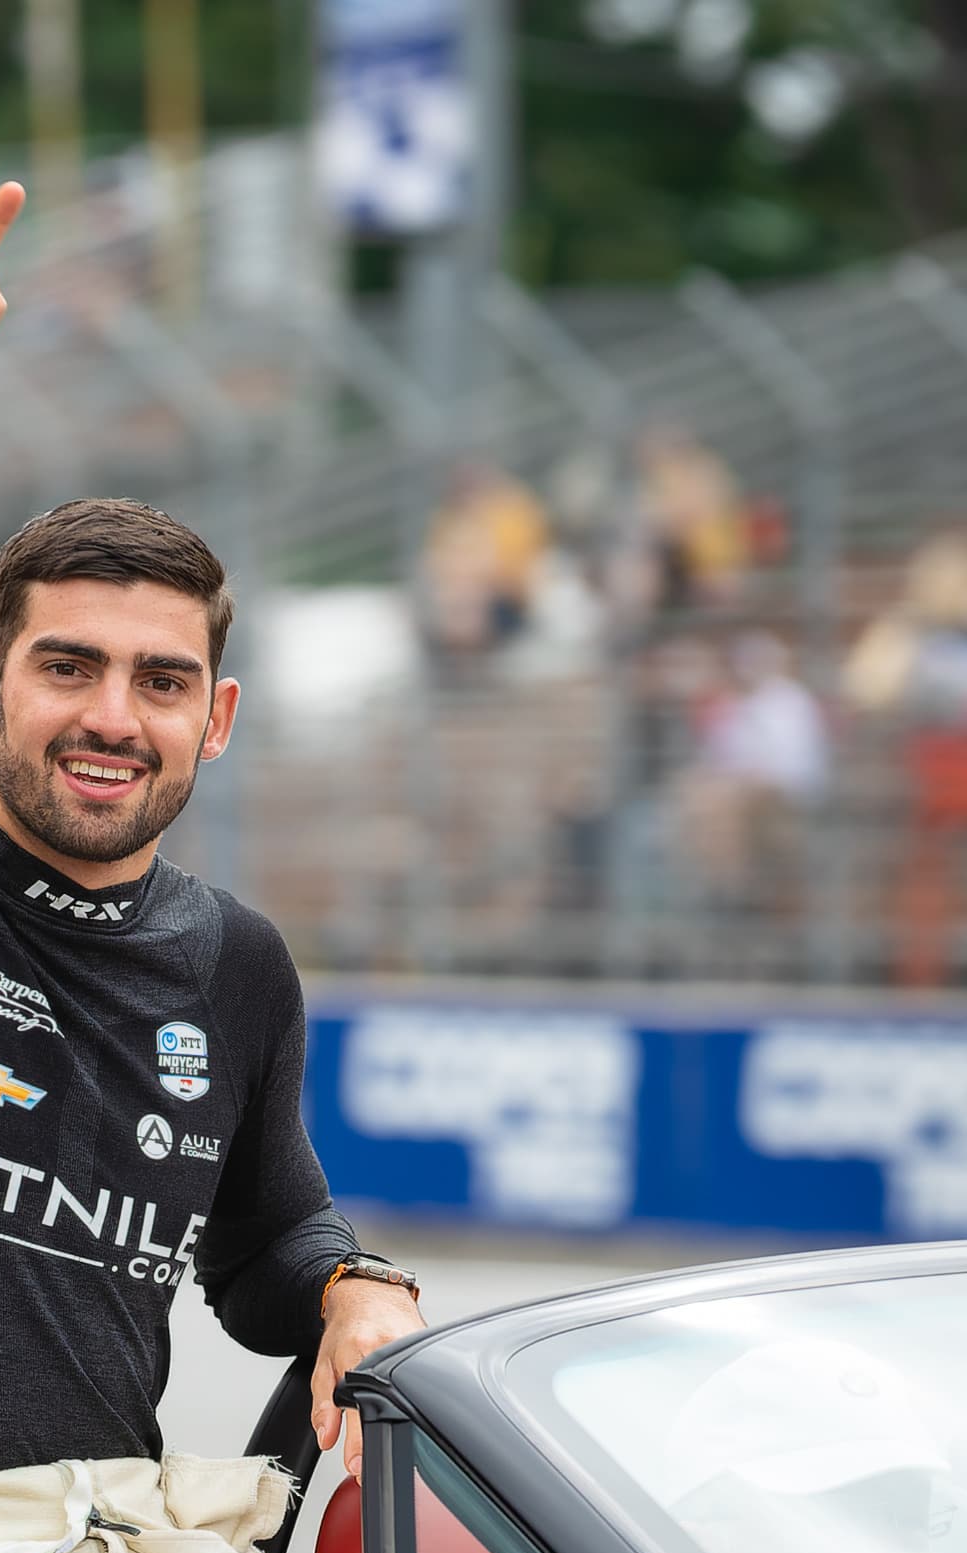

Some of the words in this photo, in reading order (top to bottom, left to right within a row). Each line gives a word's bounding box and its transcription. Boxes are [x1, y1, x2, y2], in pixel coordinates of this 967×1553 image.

[180, 1036, 201, 1049] NTT
[158, 1054, 209, 1070] INDYCAR
[169, 1066, 199, 1076] SERIES
[180, 1132, 221, 1152] AULT
